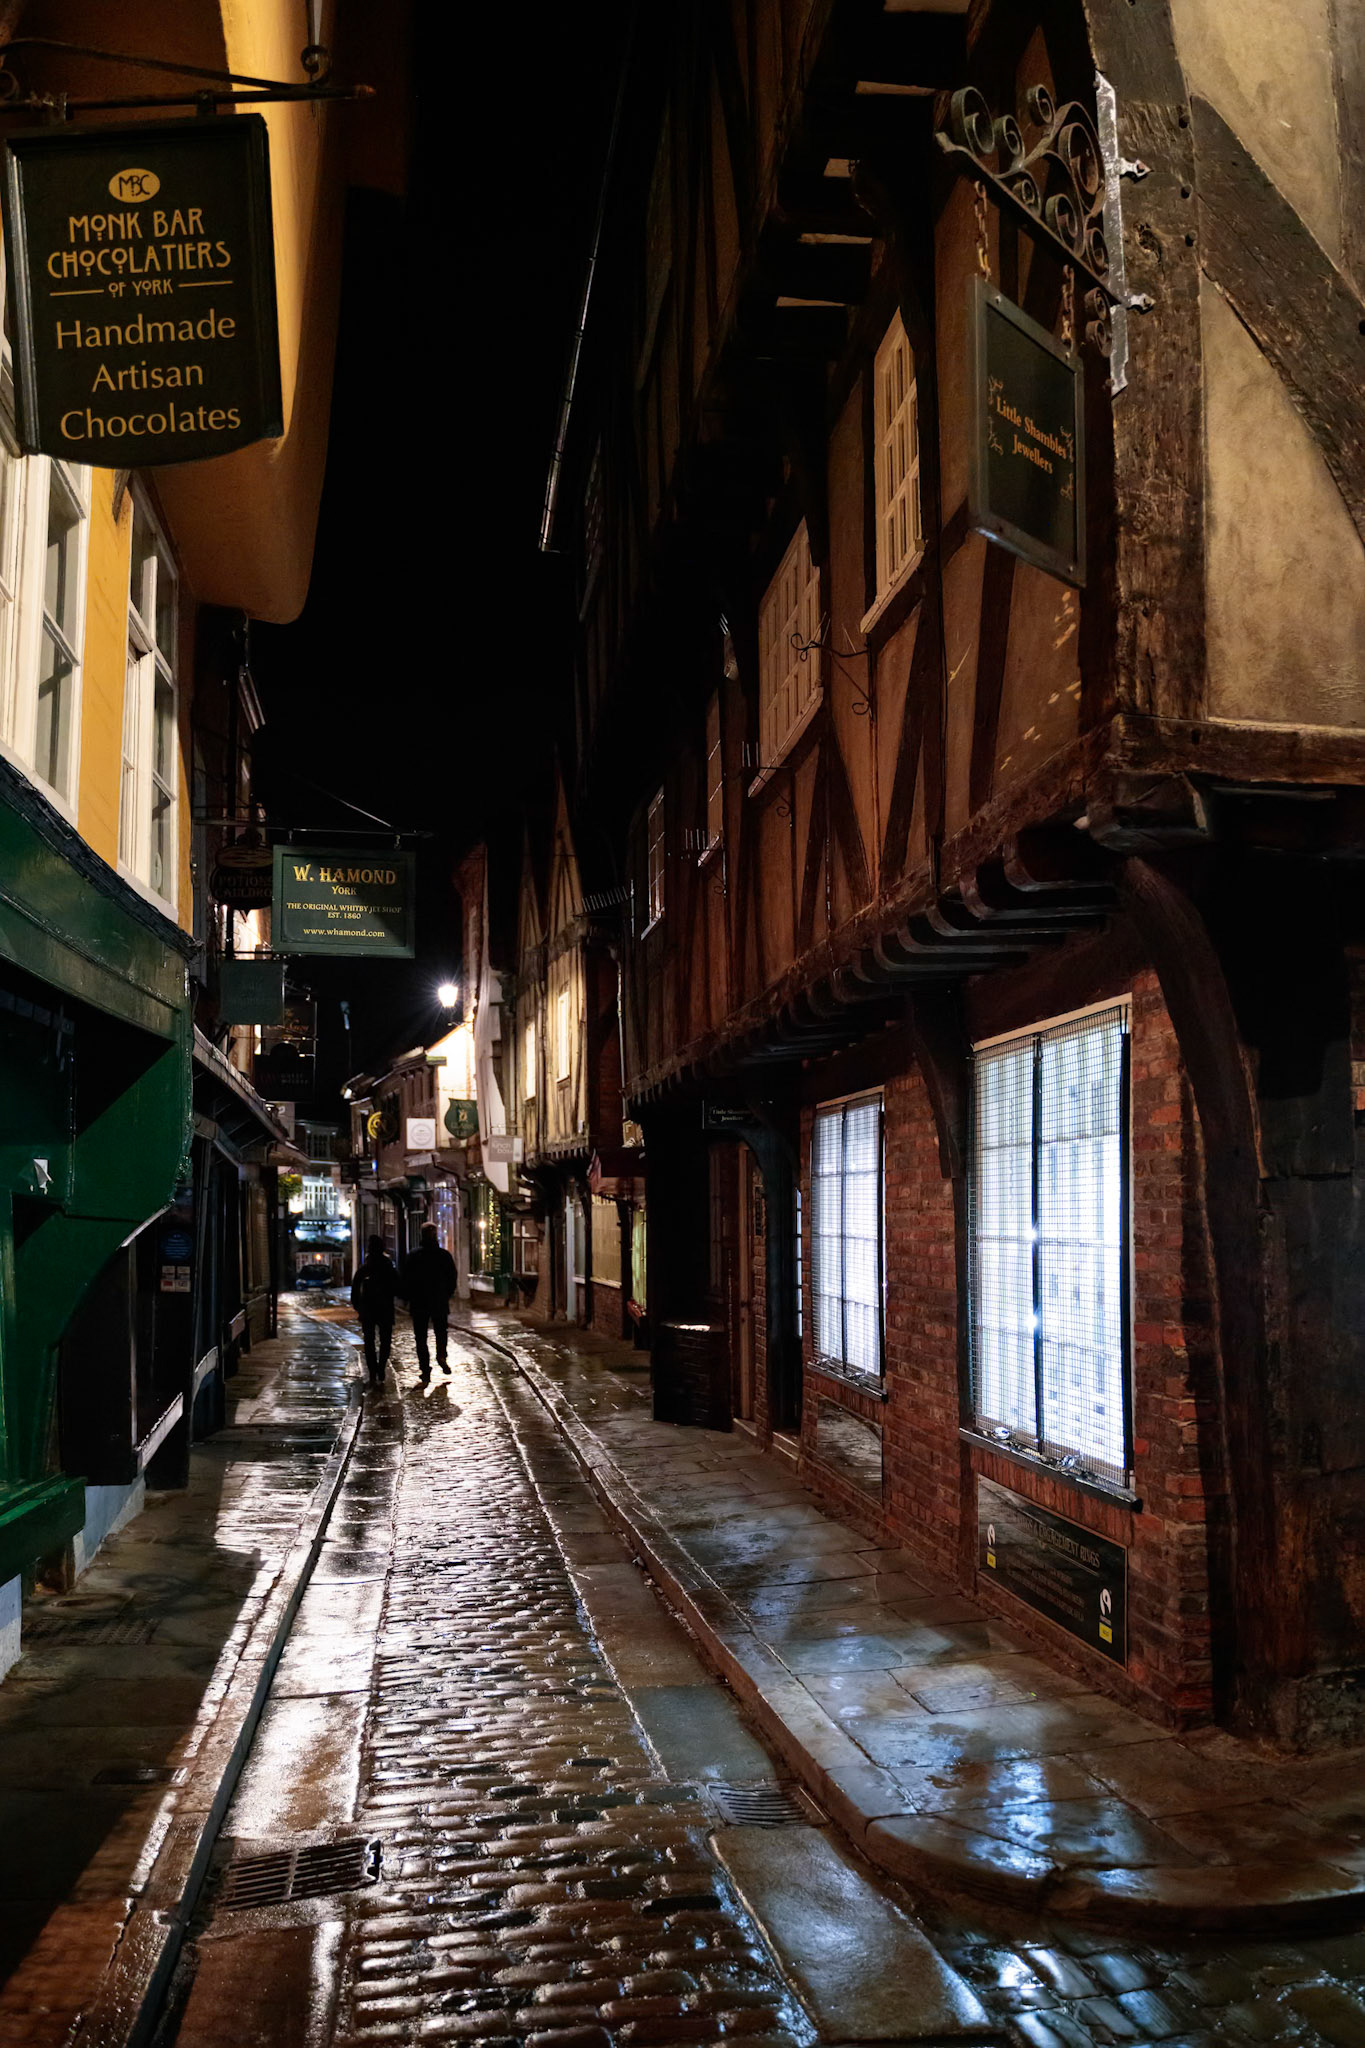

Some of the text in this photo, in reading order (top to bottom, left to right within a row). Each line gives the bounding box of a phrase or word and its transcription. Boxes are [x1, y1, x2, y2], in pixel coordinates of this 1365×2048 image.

[118, 173, 150, 197] MBC
[68, 208, 206, 244] MONK BAR
[47, 240, 232, 280] CHOCOLATIERS
[108, 278, 174, 298] OF YORK
[56, 308, 237, 350] Handmade
[91, 360, 205, 393] Artisan
[60, 402, 242, 441] Chocolates
[996, 396, 1068, 460] Little Shambles
[1012, 434, 1054, 474] Jewellers
[293, 863, 398, 886] W. HAMOND
[214, 887, 272, 898] CAULDRO
[331, 885, 358, 896] YORK
[287, 902, 403, 914] THE ORIGINAL WHITBY JET SHOP
[327, 911, 362, 920] EST. 1860
[303, 927, 385, 938] www.whamond.com
